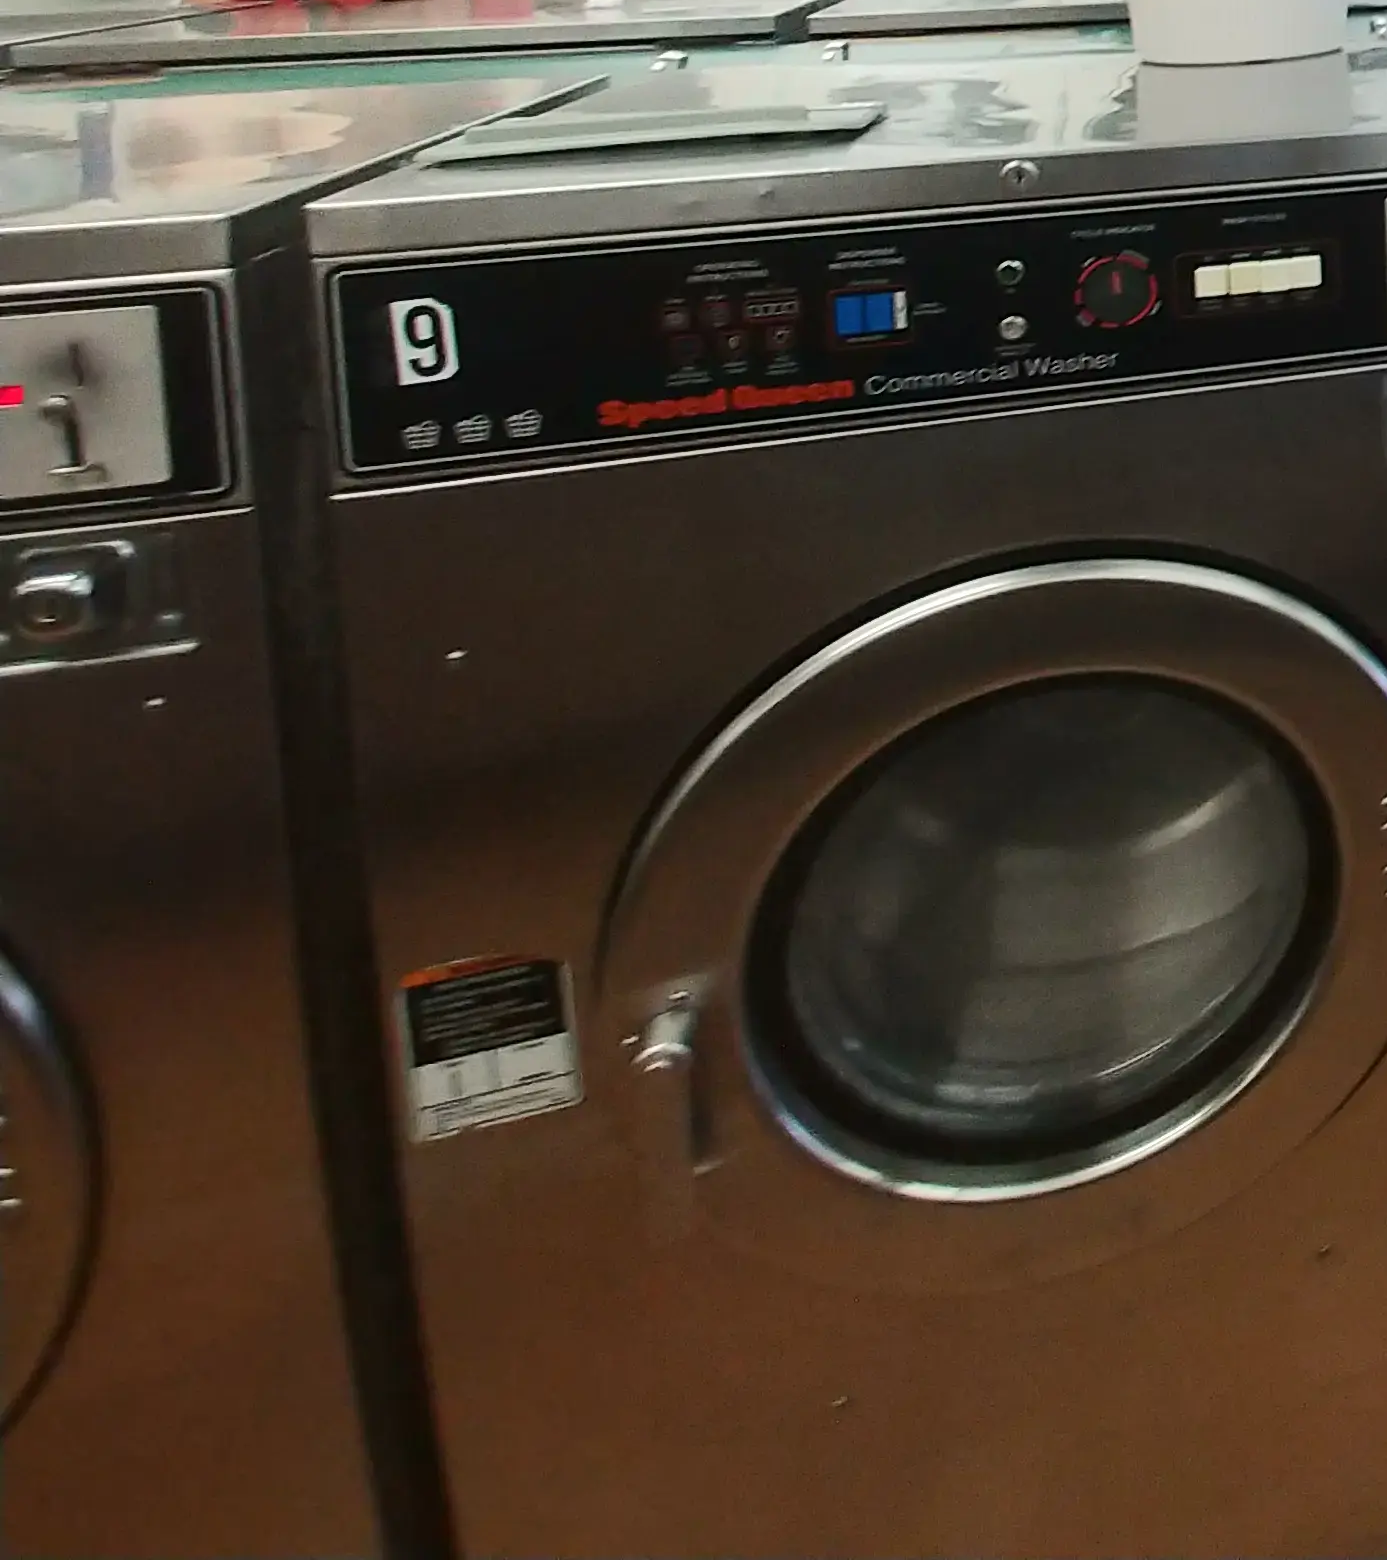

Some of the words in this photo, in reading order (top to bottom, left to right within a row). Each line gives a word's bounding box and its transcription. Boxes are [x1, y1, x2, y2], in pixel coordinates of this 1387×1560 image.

[405, 305, 446, 377] 9
[864, 359, 1019, 396] Commercial
[1024, 351, 1120, 377] Washer
